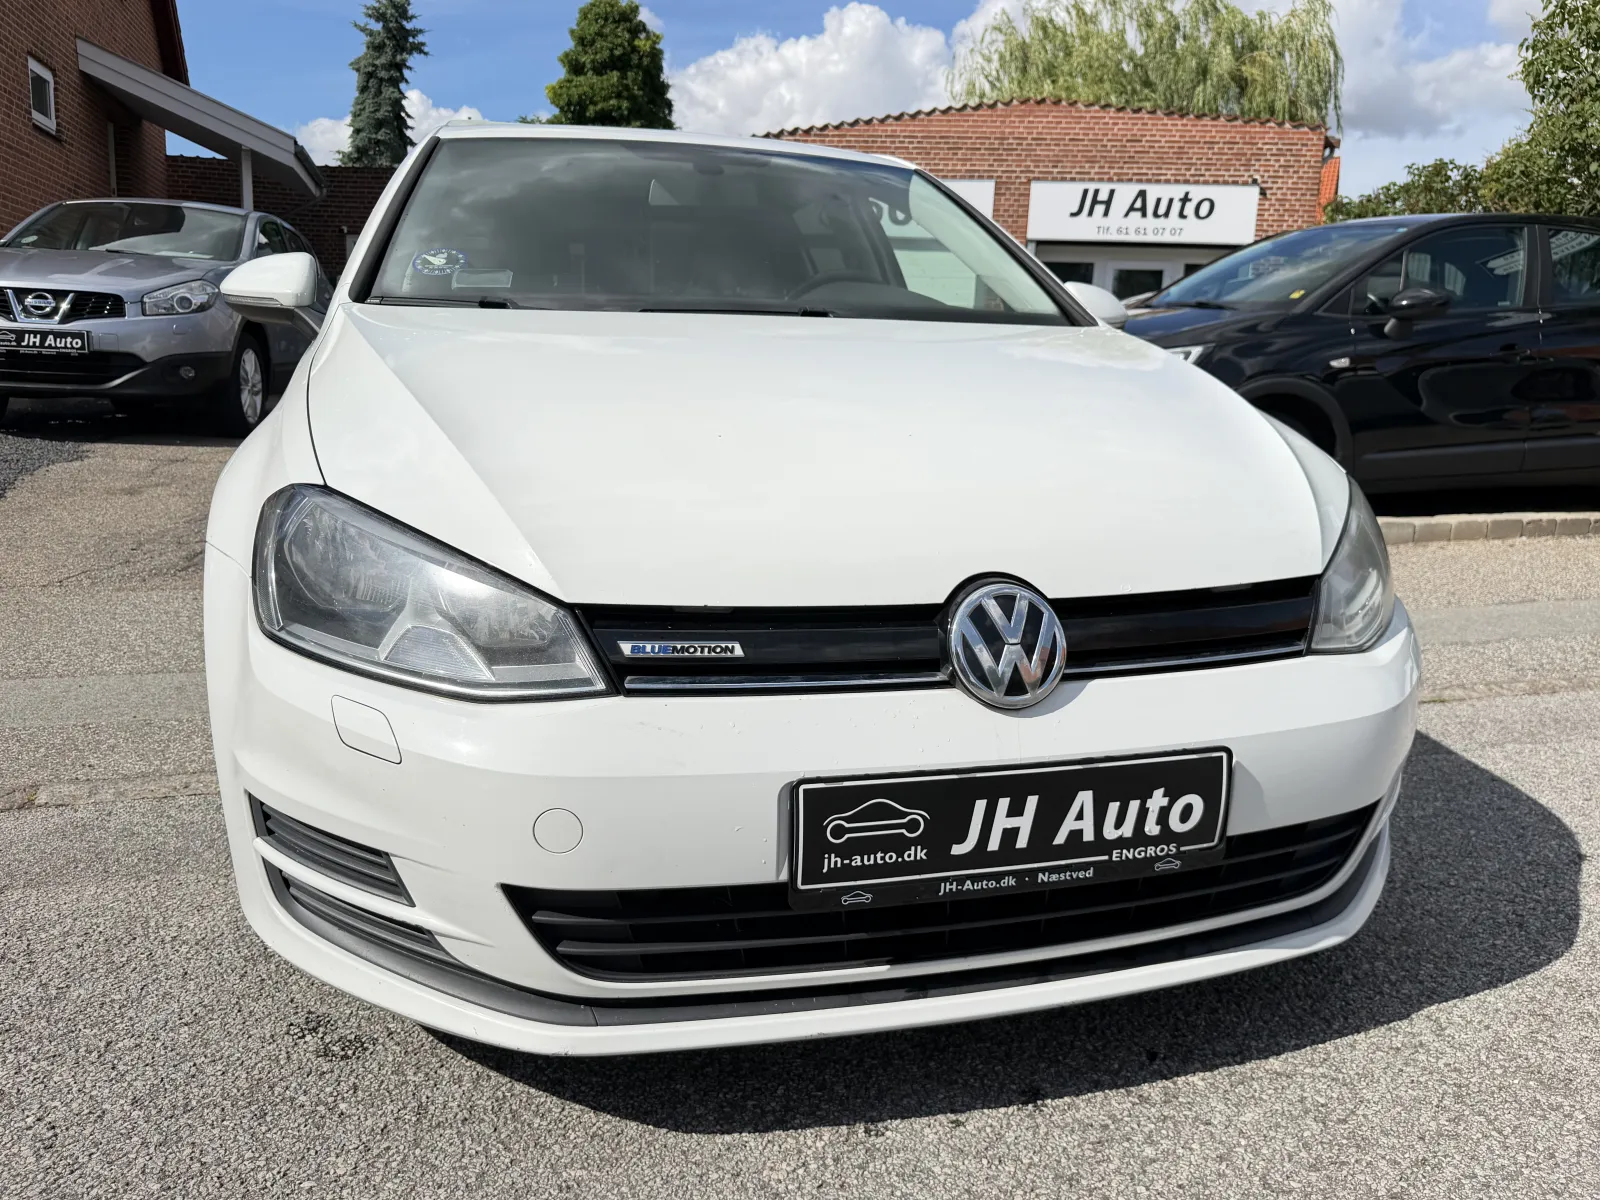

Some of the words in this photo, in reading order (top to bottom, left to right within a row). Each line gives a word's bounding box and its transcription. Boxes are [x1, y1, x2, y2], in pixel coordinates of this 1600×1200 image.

[1069, 188, 1116, 218] JH
[1123, 189, 1215, 220] Auto
[1116, 226, 1130, 236] 61
[1134, 226, 1148, 236] 61
[1152, 226, 1166, 237] 07
[1169, 226, 1184, 237] 07
[21, 333, 40, 346] JH
[44, 334, 82, 348] Auto
[630, 644, 735, 654] BLUEMOTION
[950, 794, 1040, 855] JH
[1052, 787, 1205, 845] Auto
[822, 845, 928, 873] jh-auto.dk
[1112, 843, 1178, 861] ENGROS
[938, 876, 1017, 896] JH-Auto.dk
[1037, 867, 1094, 884] Næstved
